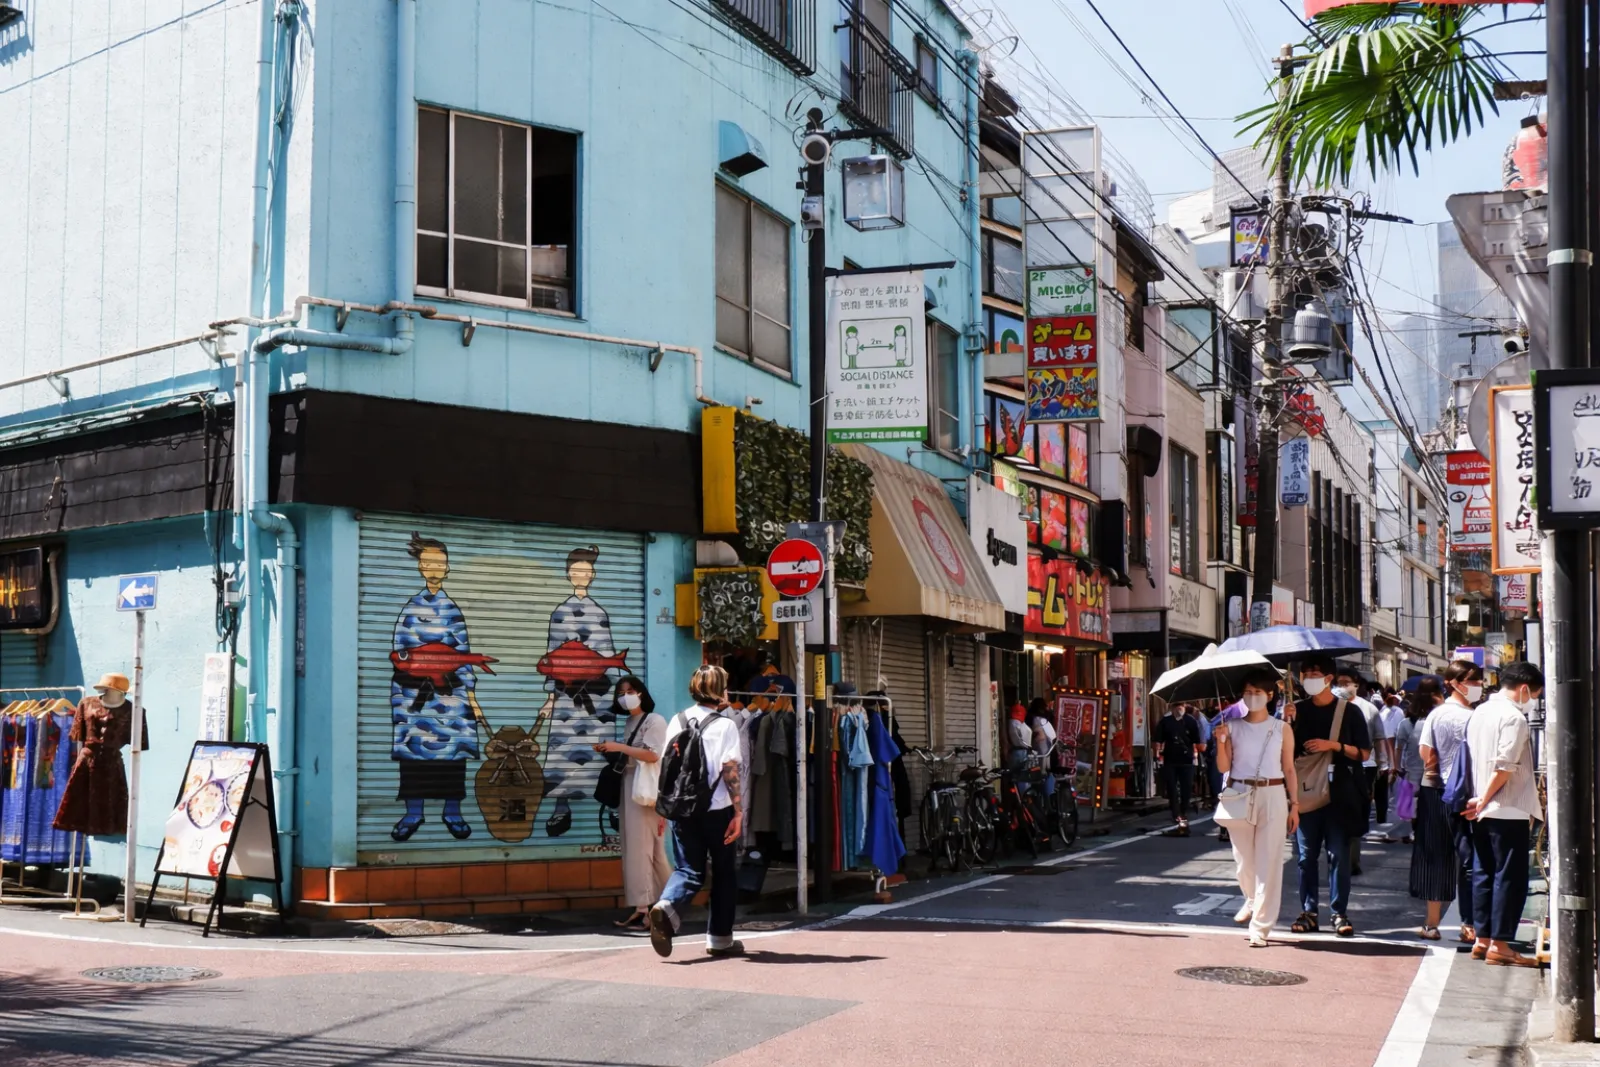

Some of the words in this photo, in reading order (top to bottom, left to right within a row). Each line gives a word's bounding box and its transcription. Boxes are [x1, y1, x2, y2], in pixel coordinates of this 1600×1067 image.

[1031, 272, 1047, 282] 2F
[1032, 322, 1093, 343] ゲーム
[1033, 344, 1093, 362] 買います
[840, 371, 872, 381] SOCIAL
[873, 369, 915, 380] DISTANCE
